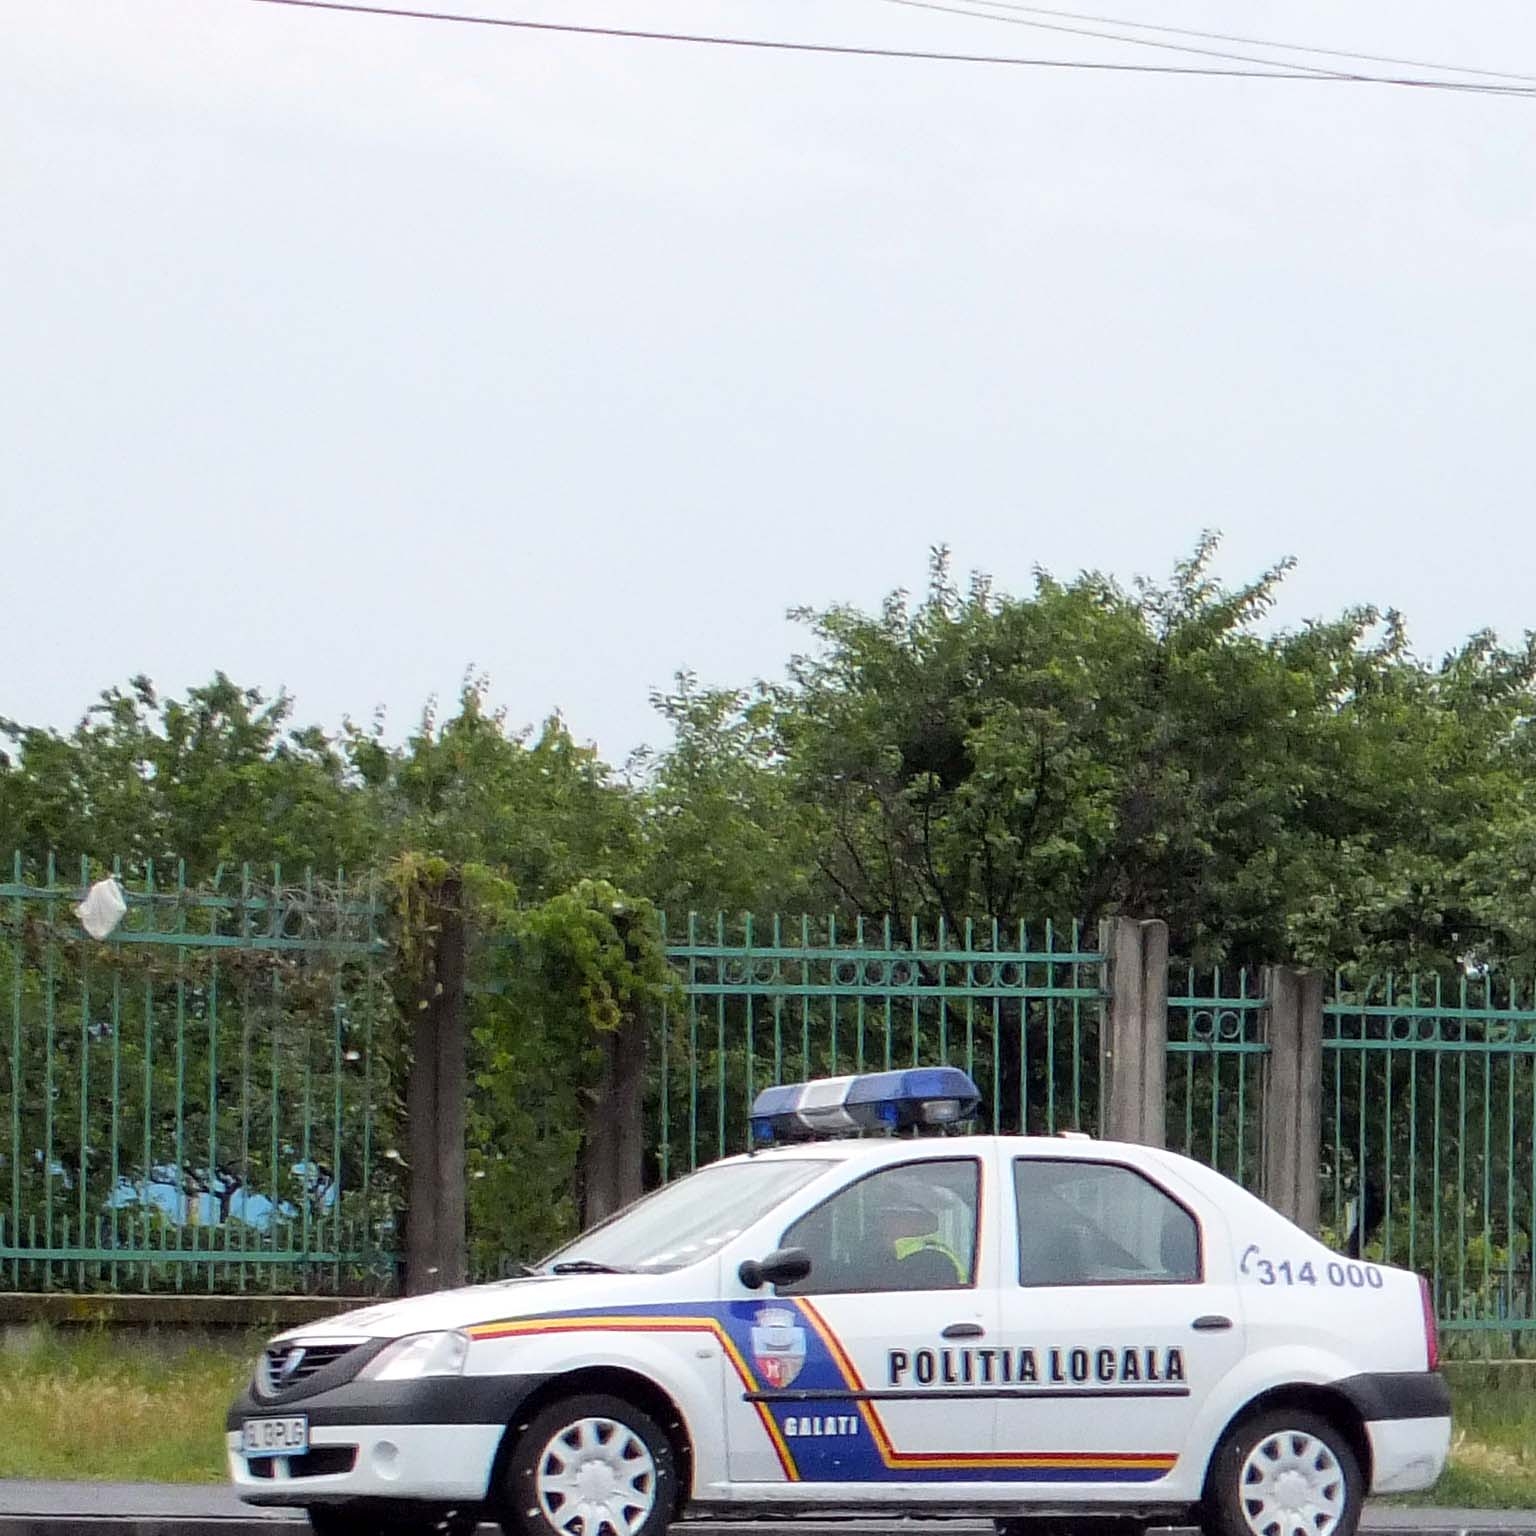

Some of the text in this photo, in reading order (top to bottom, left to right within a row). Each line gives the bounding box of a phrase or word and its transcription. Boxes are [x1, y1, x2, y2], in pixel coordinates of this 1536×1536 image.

[1257, 1260, 1383, 1288] 314 000
[889, 1346, 1187, 1385] POLITIA LOCALA
[784, 1416, 858, 1436] GALATI
